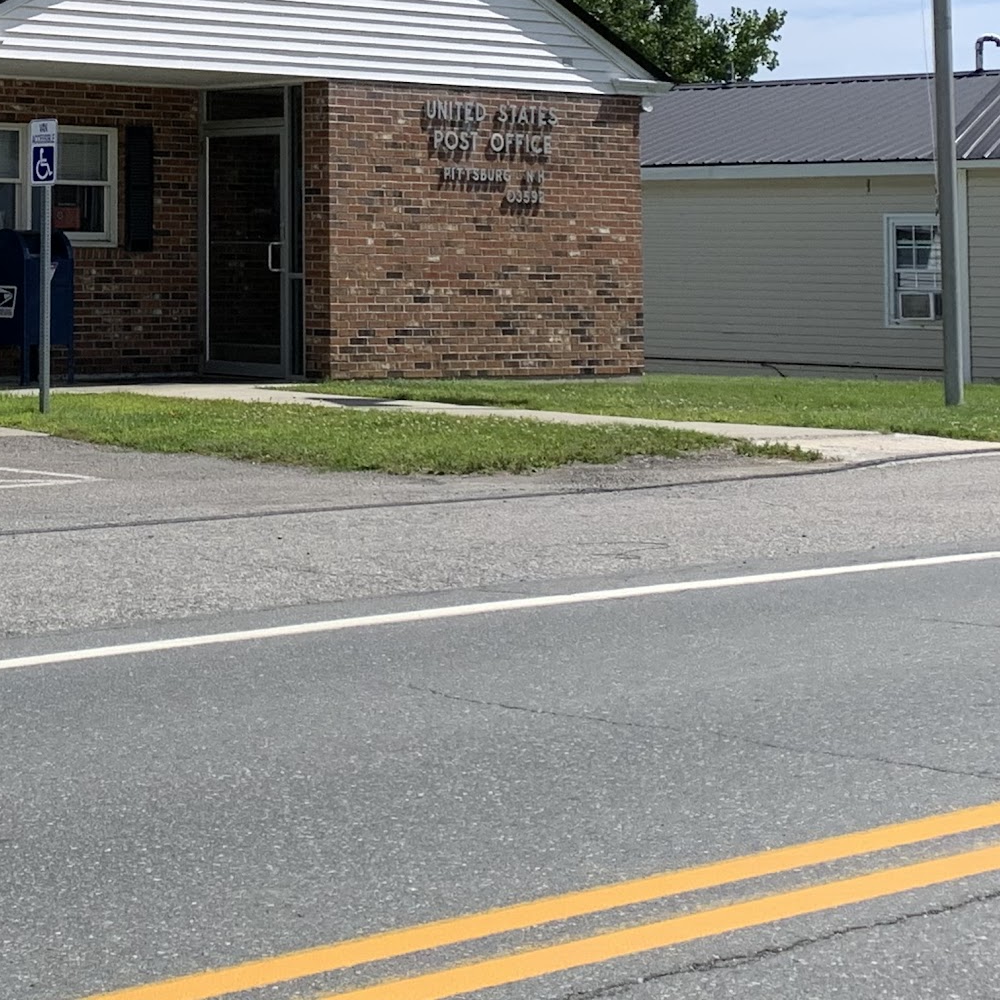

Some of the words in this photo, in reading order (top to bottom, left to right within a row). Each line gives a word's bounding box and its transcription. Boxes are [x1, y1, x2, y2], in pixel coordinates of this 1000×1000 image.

[426, 100, 486, 122] UNITED
[498, 104, 558, 127] STATES
[433, 130, 478, 151] POST
[490, 133, 552, 155] OFFICE
[443, 167, 511, 182] PITTSBURG
[506, 190, 545, 204] 03592
